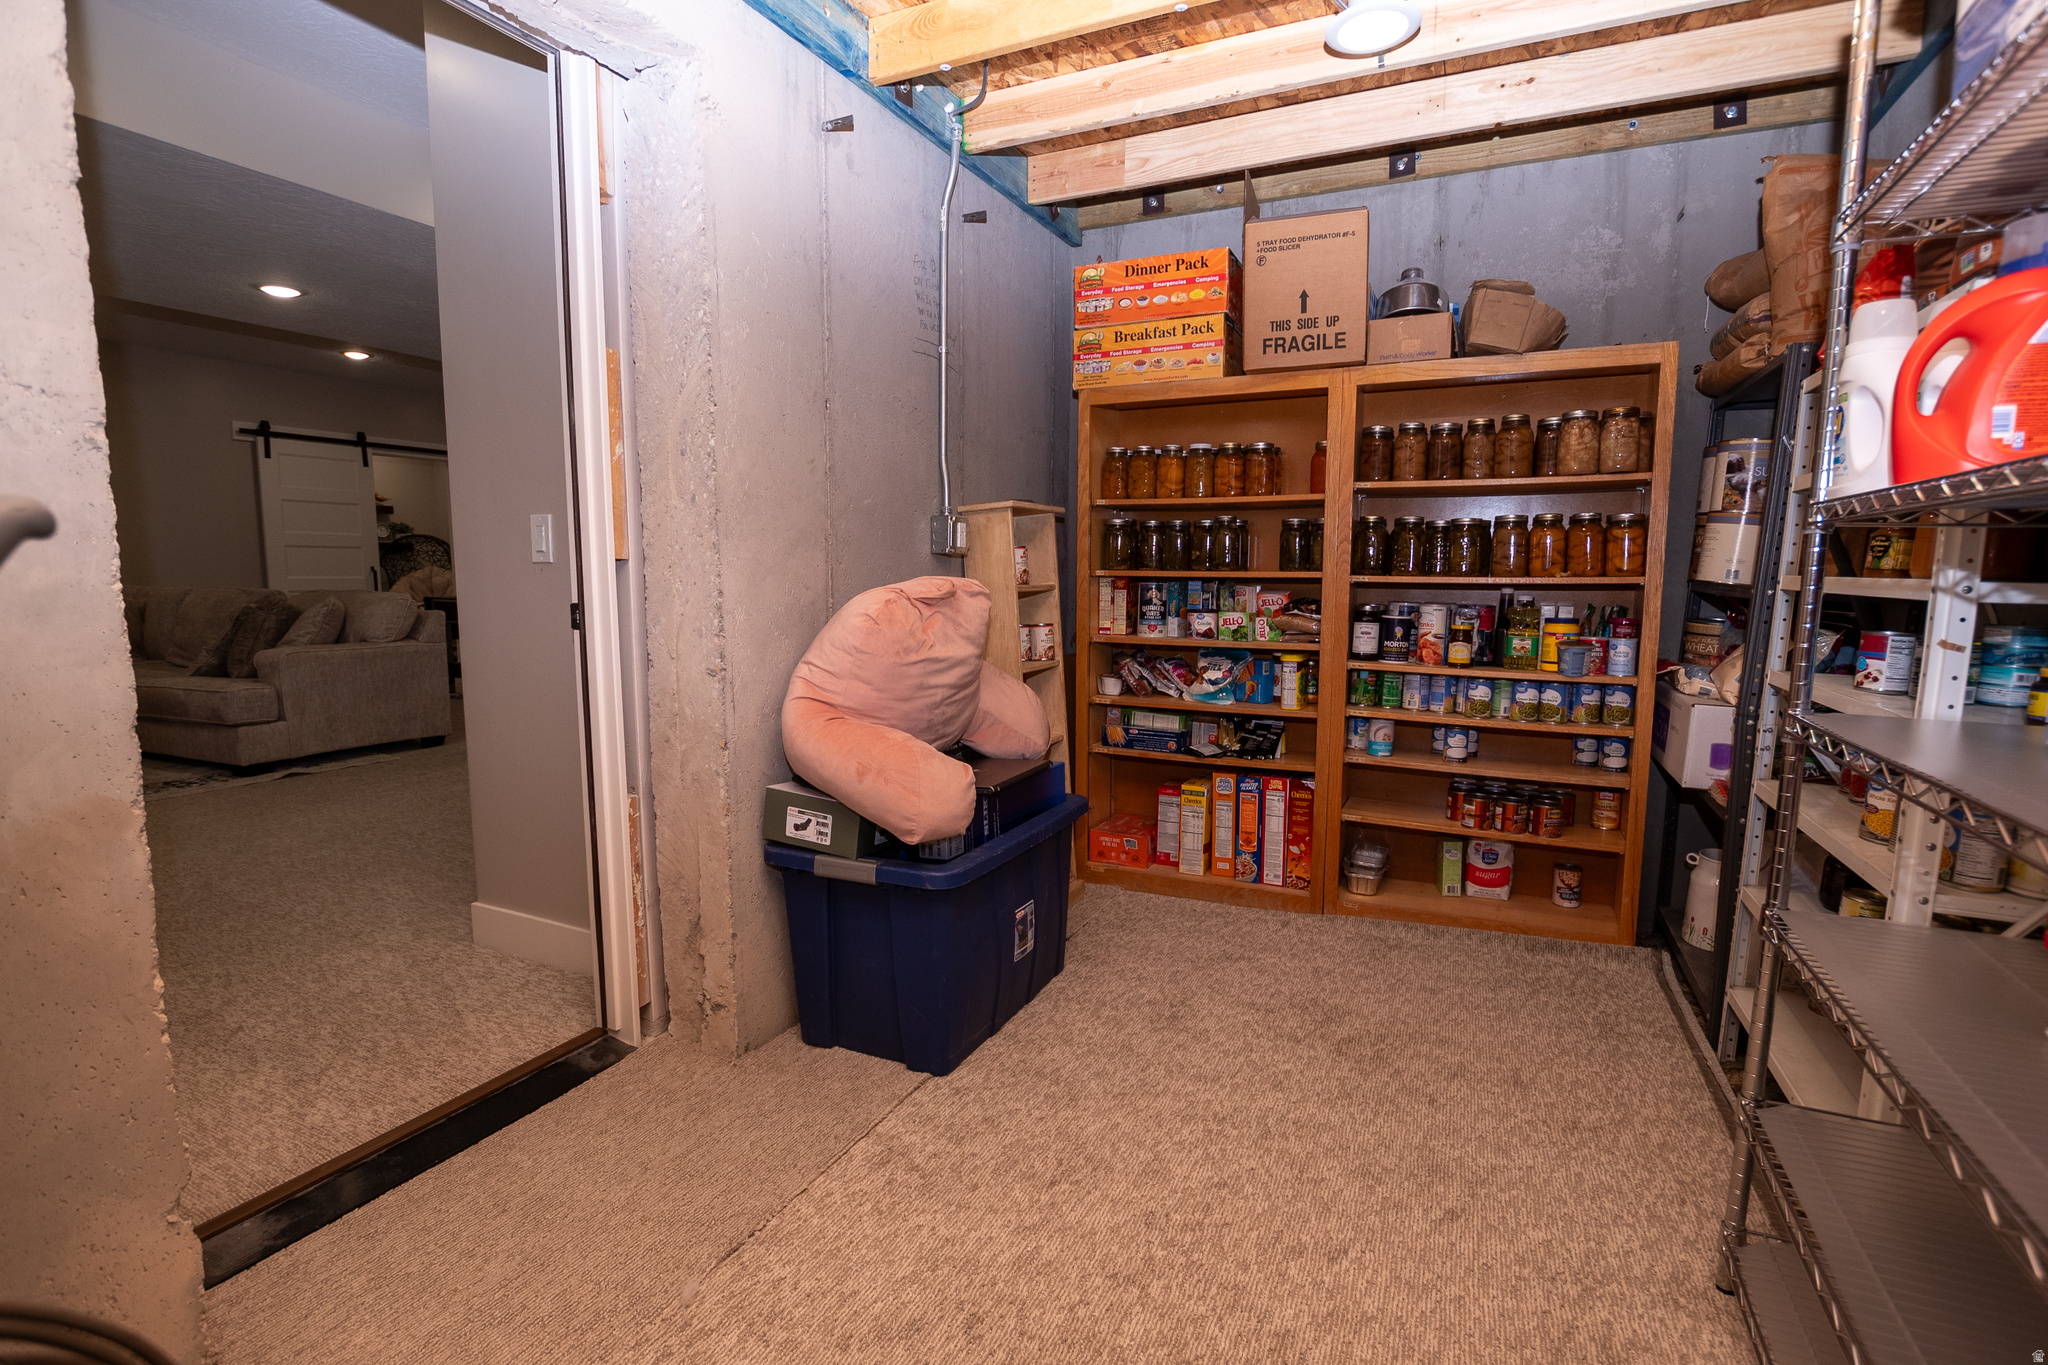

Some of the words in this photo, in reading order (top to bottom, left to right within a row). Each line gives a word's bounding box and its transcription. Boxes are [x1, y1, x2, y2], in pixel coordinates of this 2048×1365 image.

[1262, 239, 1278, 247] TRAY
[1298, 231, 1341, 242] DEHYDRATOR
[1278, 243, 1301, 252] SLICER
[1125, 262, 1171, 278] Dinner
[1175, 256, 1209, 272] Pack
[1125, 284, 1145, 292] Storage
[1153, 279, 1187, 288] Emergencies
[1195, 275, 1219, 283] Camping
[1270, 319, 1291, 332] THIS
[1297, 317, 1319, 330] SIDE
[1326, 315, 1340, 328] UP
[1114, 325, 1177, 343] Breakfast
[1181, 320, 1215, 336] Pack
[1122, 348, 1143, 356] Storage
[1150, 344, 1184, 353] Emergencies
[1262, 332, 1347, 355] FRAGILE
[1260, 597, 1284, 607] JELL-O
[1221, 616, 1244, 626] JELL-O
[1257, 619, 1266, 640] JELL-O
[1685, 641, 1719, 654] WHEAT
[1183, 797, 1203, 805] Cheerios
[1290, 790, 1312, 799] Cheerios
[1474, 870, 1500, 880] sugar
